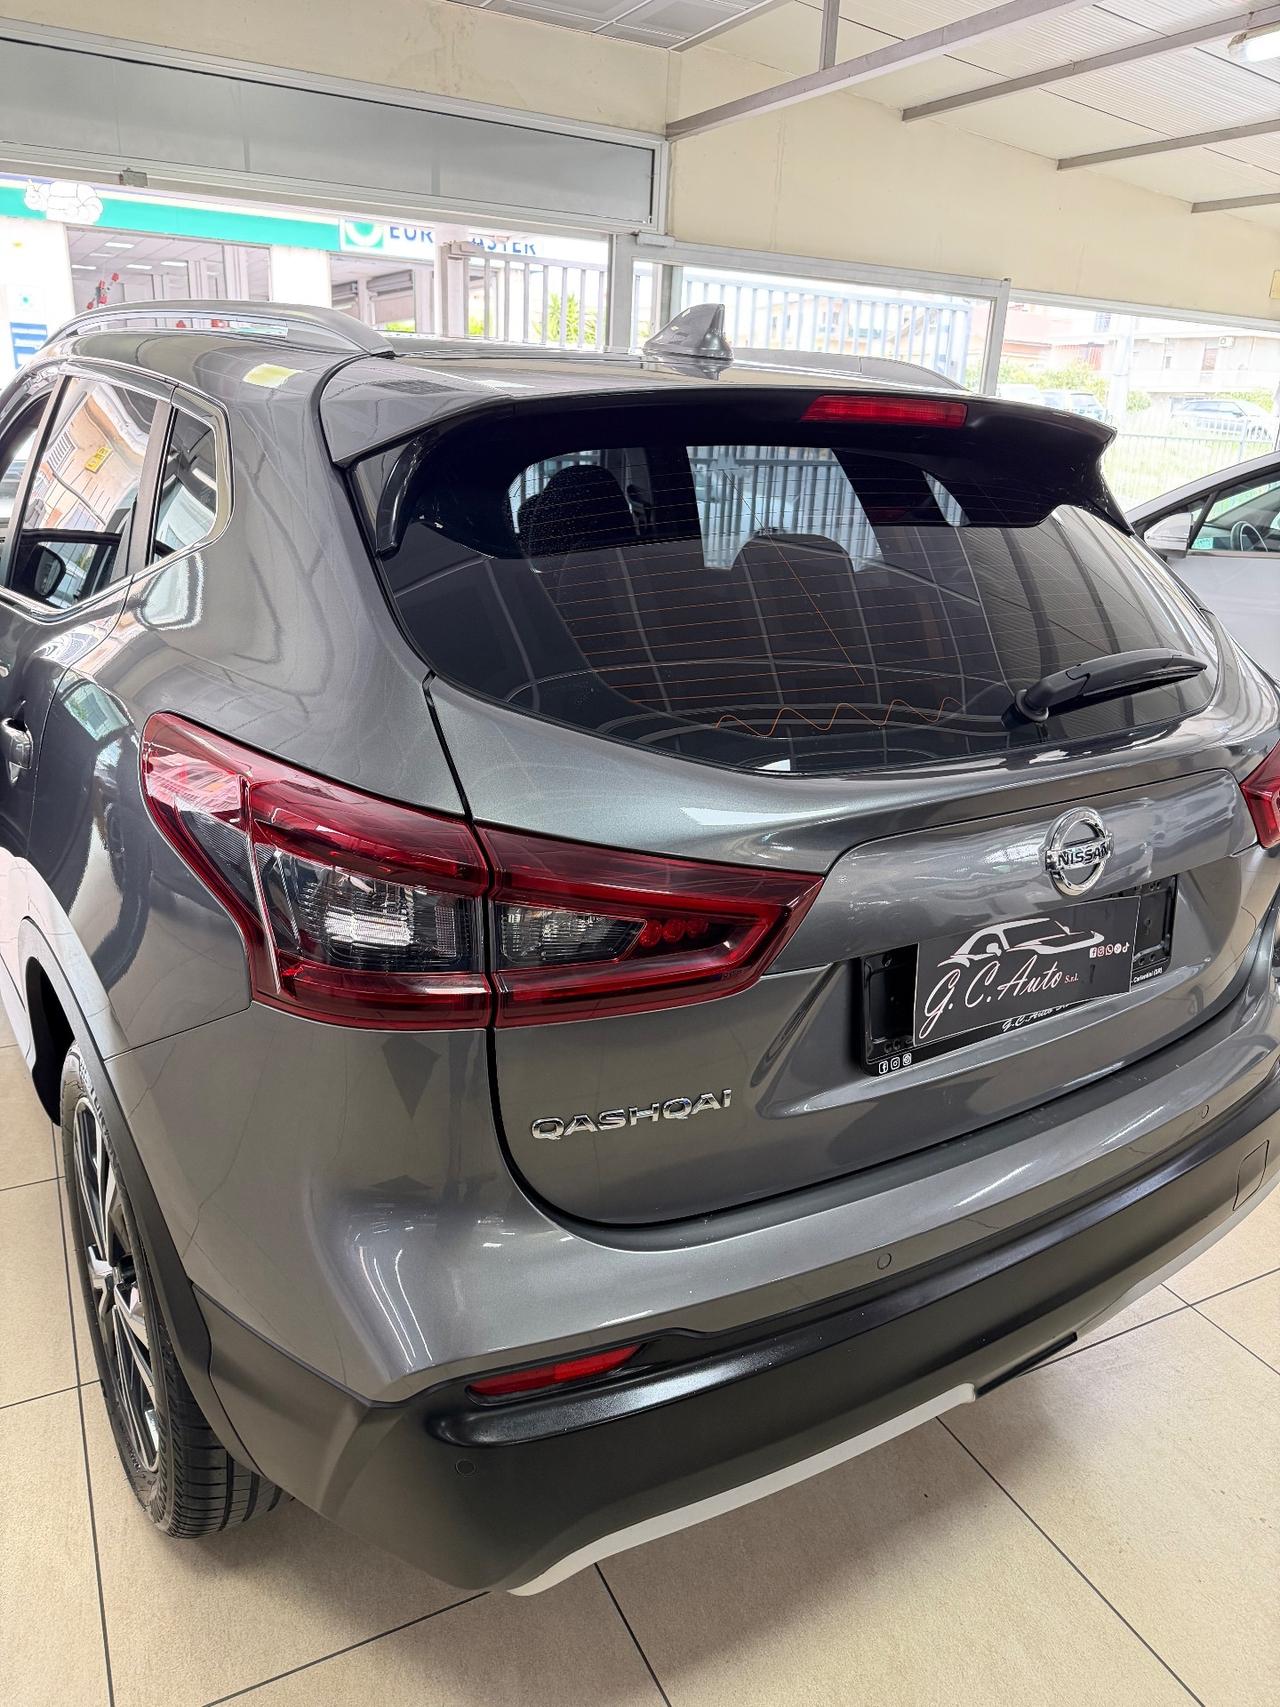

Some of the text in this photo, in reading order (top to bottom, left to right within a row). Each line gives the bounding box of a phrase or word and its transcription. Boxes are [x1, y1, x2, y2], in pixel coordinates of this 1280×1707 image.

[1057, 842, 1109, 867] NISSAN
[997, 954, 1063, 1000] Auto
[530, 1088, 733, 1141] QASHQAI
